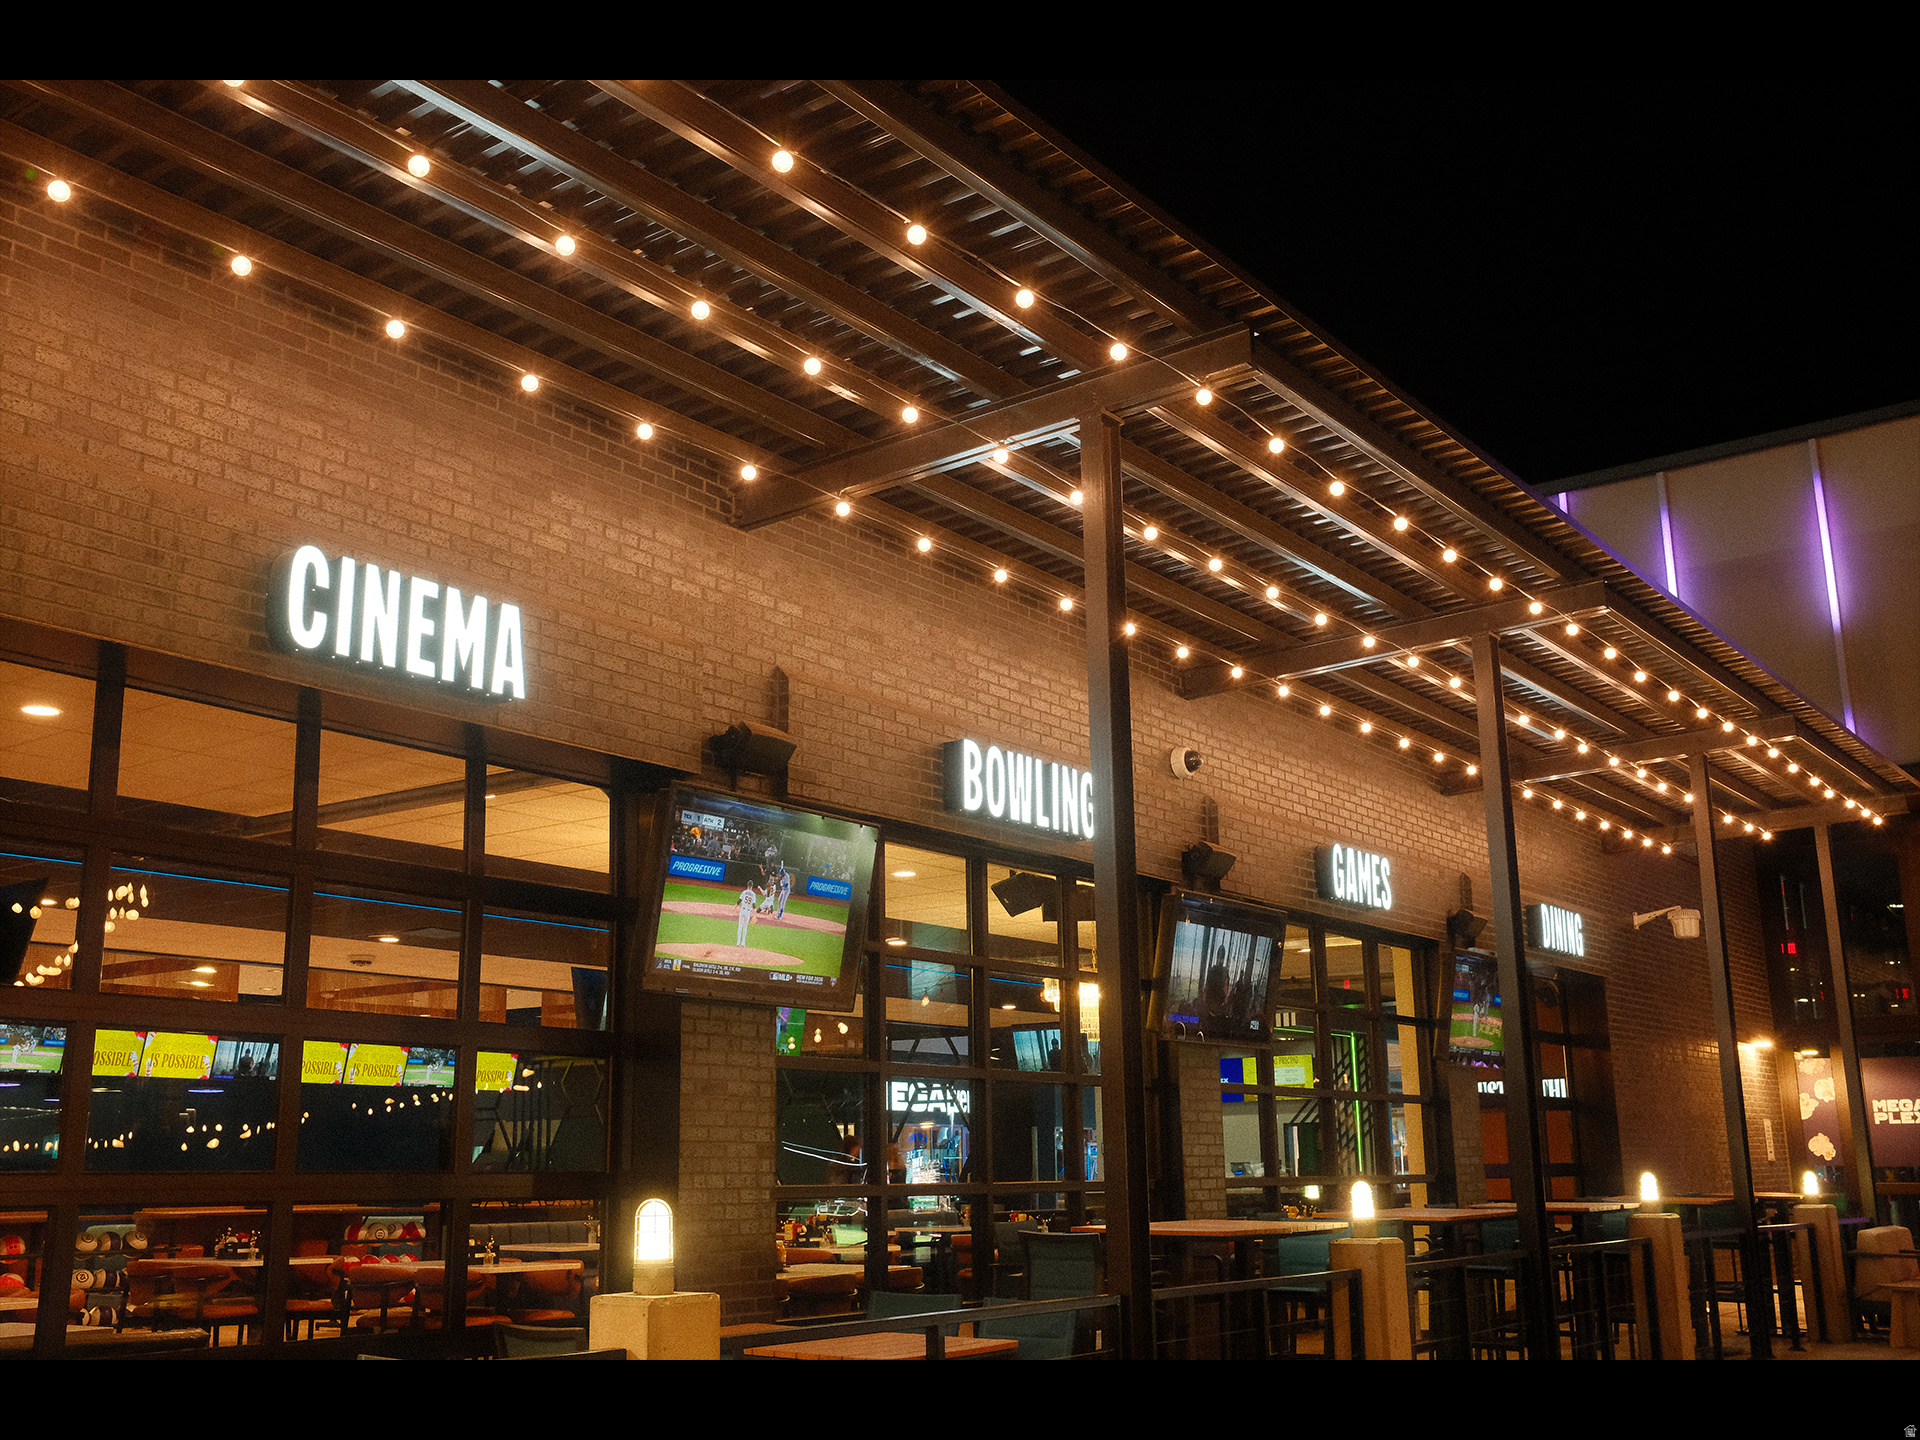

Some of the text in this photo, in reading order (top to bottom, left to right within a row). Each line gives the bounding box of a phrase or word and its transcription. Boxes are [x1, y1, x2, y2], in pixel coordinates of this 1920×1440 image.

[288, 545, 526, 699] CINEMA
[964, 738, 1095, 839] BOWLING
[672, 860, 723, 876] PROGRESSIVE
[1332, 843, 1393, 911] GAMES
[809, 880, 850, 896] PROGRESSIVE
[1541, 903, 1585, 957] DINING
[150, 1052, 206, 1069] IS POSSIBLE
[362, 1063, 400, 1078] POSSIBLE
